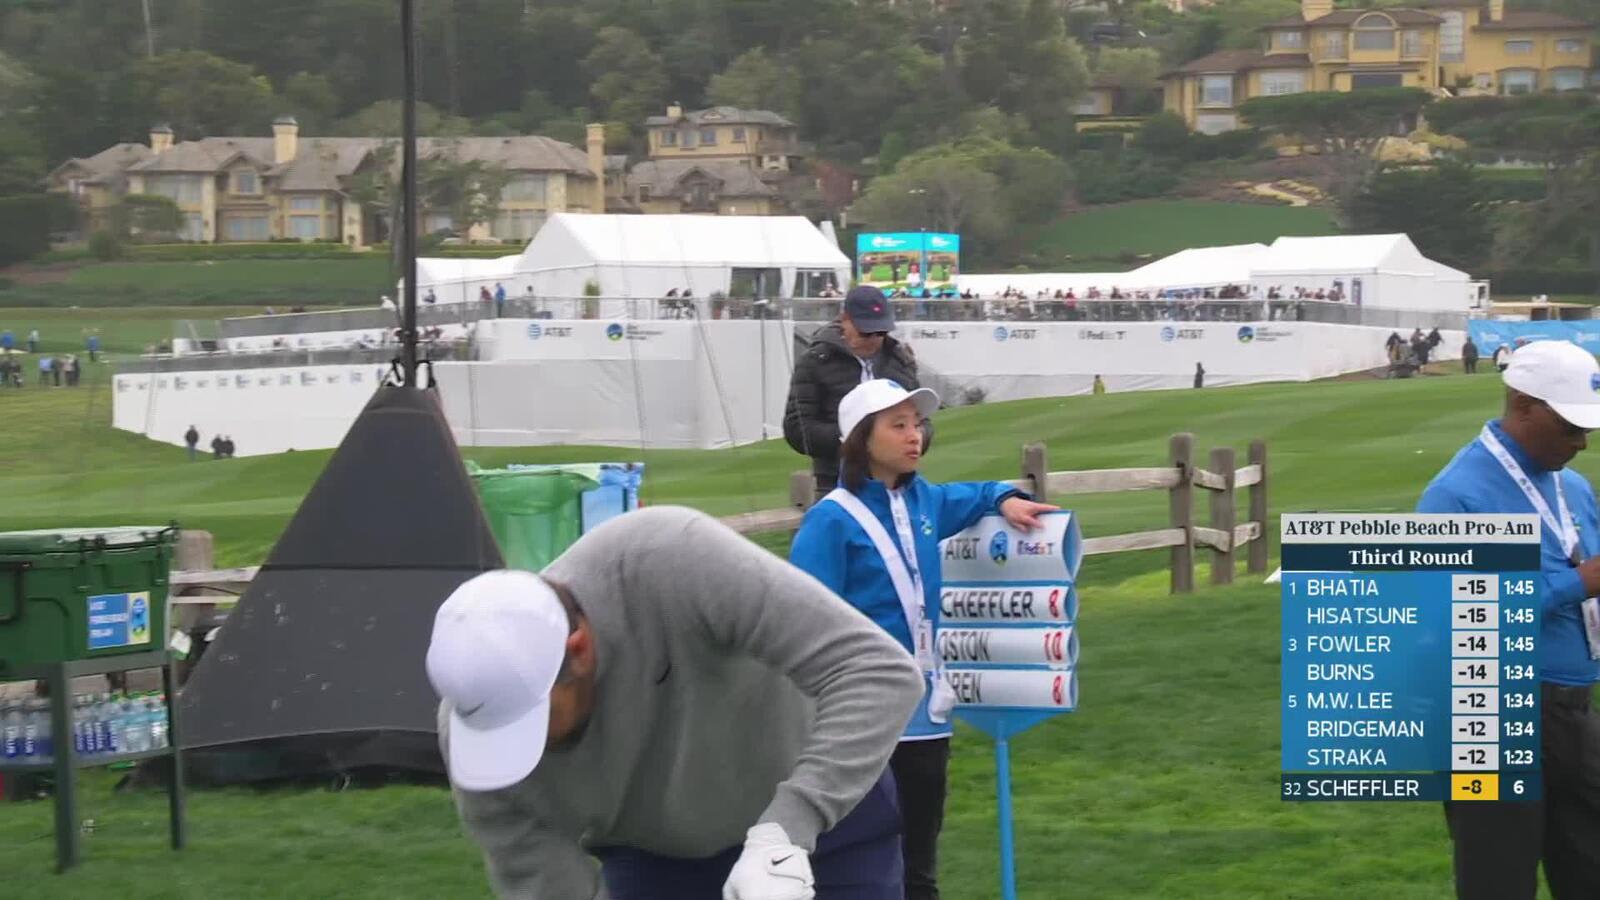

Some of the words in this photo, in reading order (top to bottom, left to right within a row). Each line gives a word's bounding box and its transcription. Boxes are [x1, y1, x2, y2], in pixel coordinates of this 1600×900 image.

[1010, 328, 1038, 340] AT&T
[945, 538, 981, 561] AT&T
[940, 590, 1036, 618] CHEFFLER
[1049, 588, 1059, 619] 8
[937, 630, 991, 661] OSTON
[1044, 630, 1062, 661] 10
[946, 672, 982, 704] REN
[1052, 674, 1063, 705] 8
